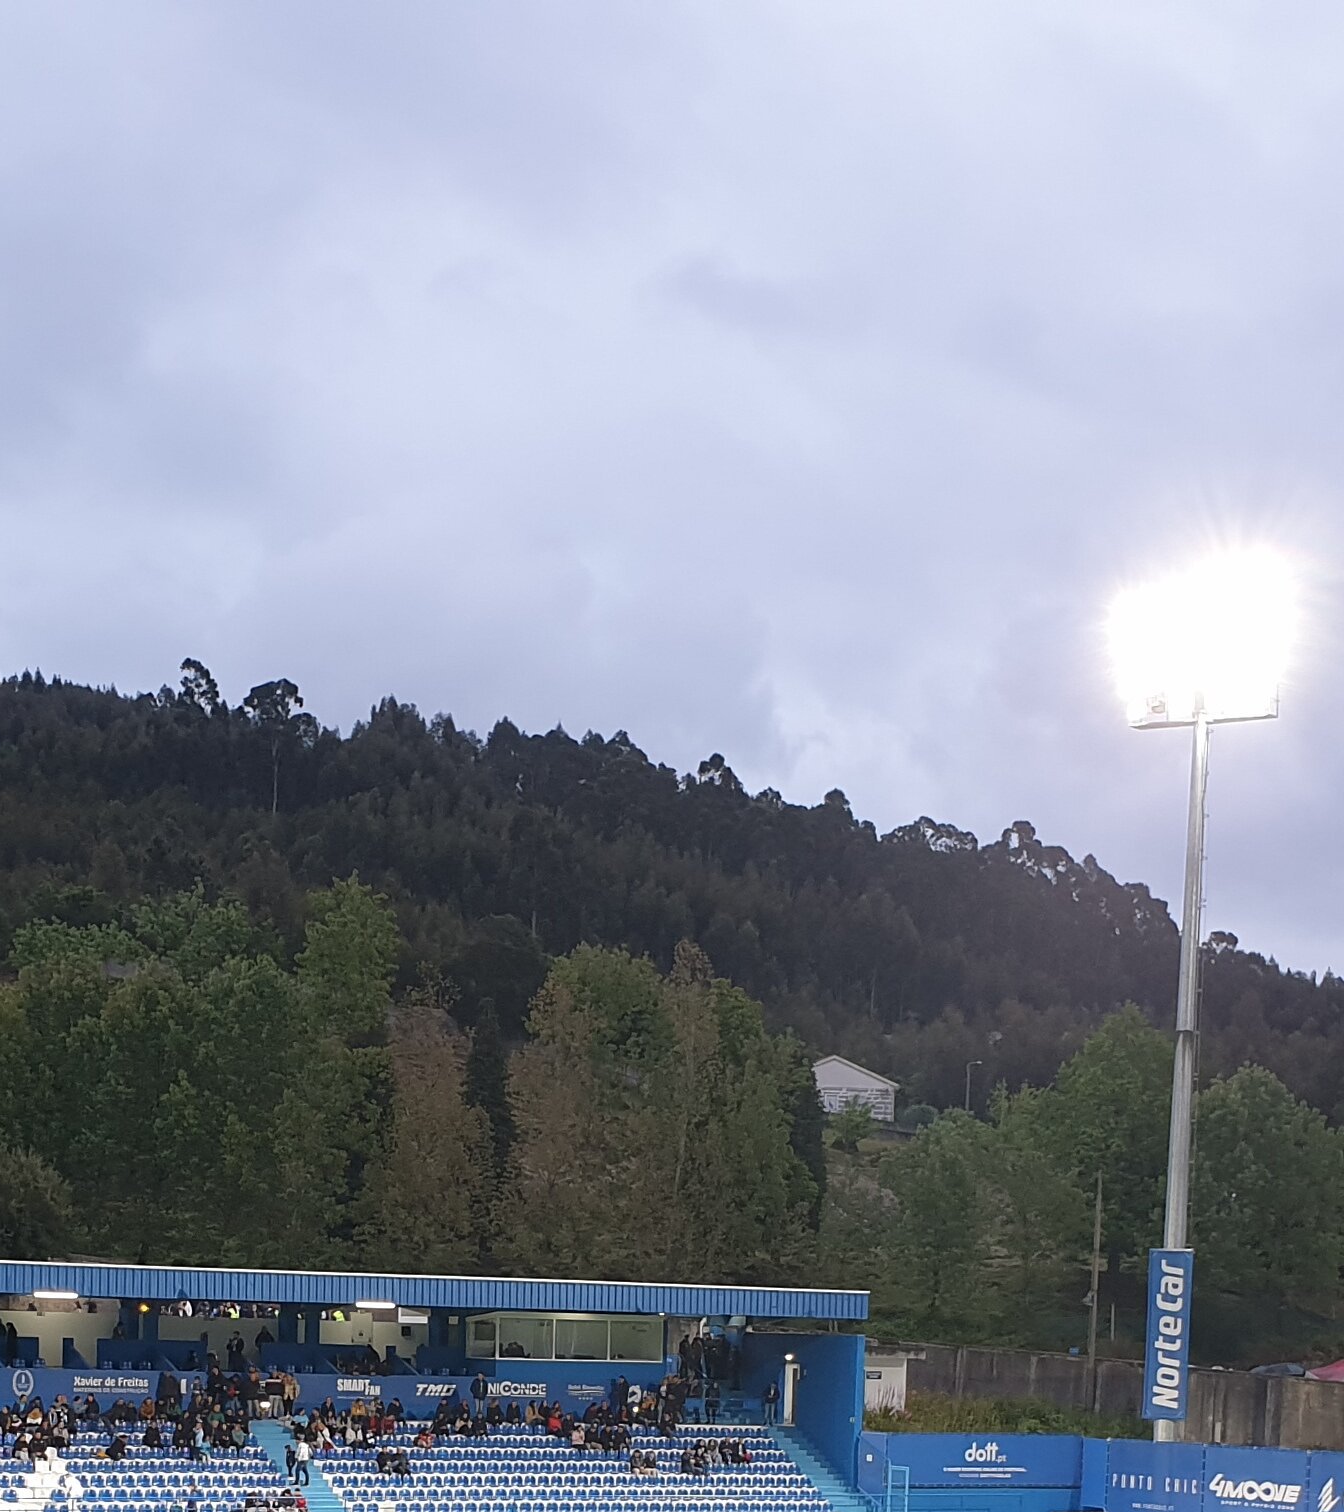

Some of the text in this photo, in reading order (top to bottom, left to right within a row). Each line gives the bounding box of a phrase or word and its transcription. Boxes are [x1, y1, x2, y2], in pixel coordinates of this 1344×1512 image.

[74, 1376, 148, 1388] Xavier de Freitas
[337, 1379, 370, 1392] SMART
[487, 1381, 547, 1397] NICONDE
